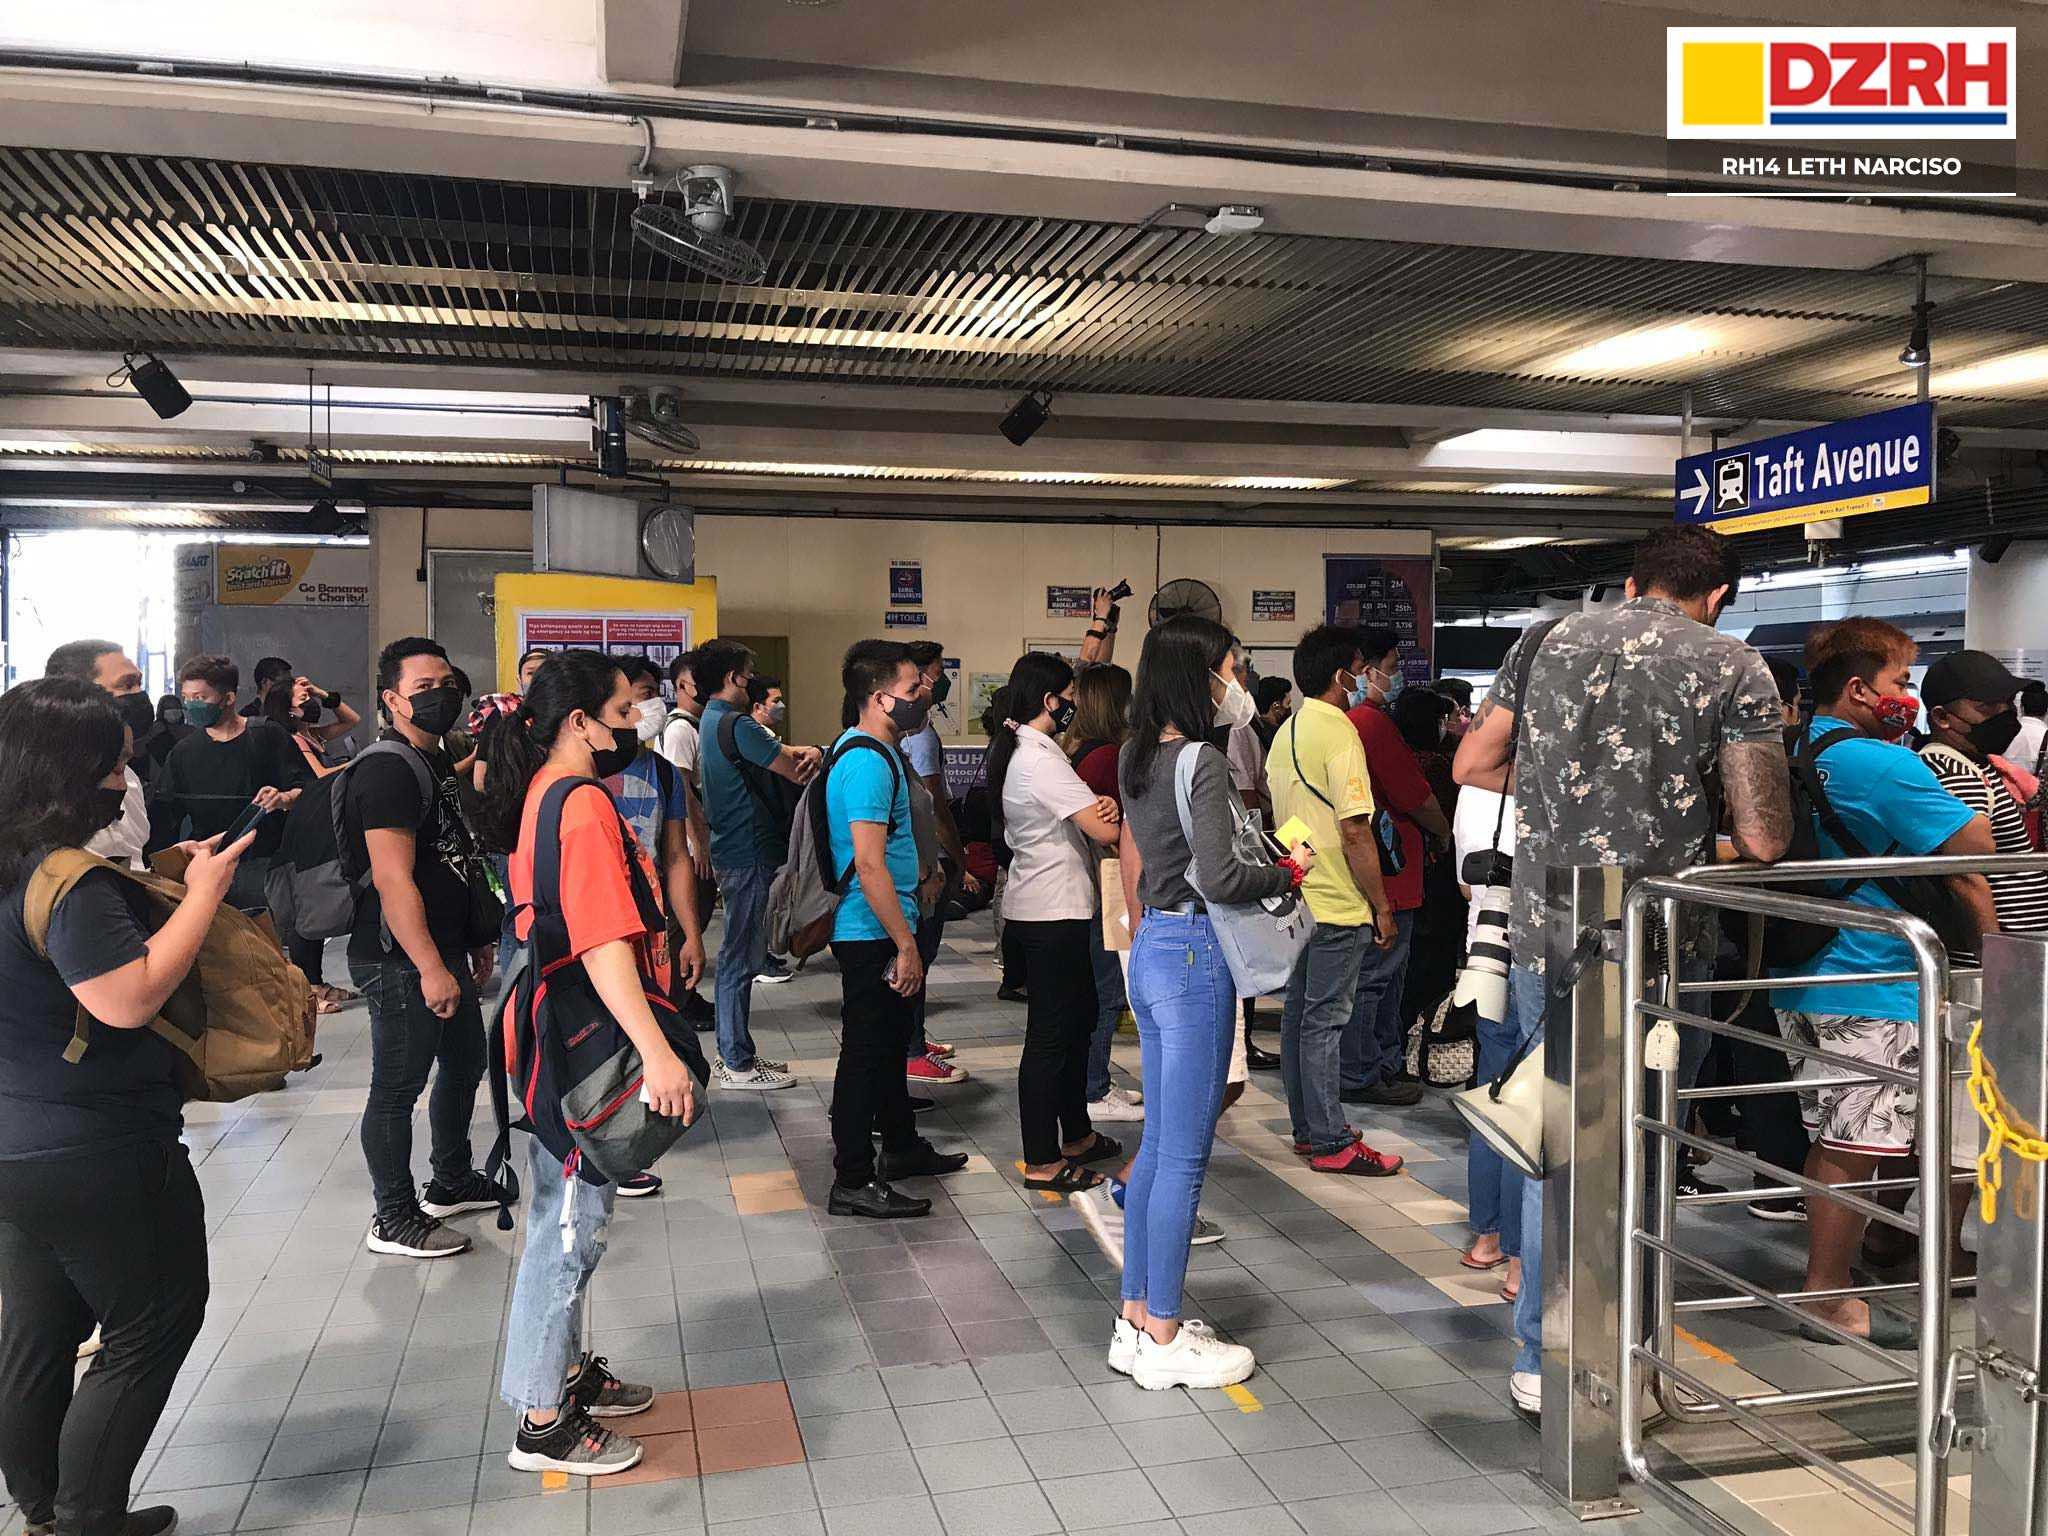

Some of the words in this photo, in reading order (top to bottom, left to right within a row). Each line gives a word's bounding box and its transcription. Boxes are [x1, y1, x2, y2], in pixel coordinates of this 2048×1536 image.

[1754, 446, 1805, 500] Taft
[1812, 435, 1920, 489] Avenue
[299, 583, 316, 593] Go
[318, 583, 368, 594] Bananas
[318, 592, 365, 602] Charity!
[1394, 602, 1412, 612] 25th
[900, 613, 926, 622] TOILET
[946, 753, 987, 765] BUH
[945, 768, 987, 776] otocols
